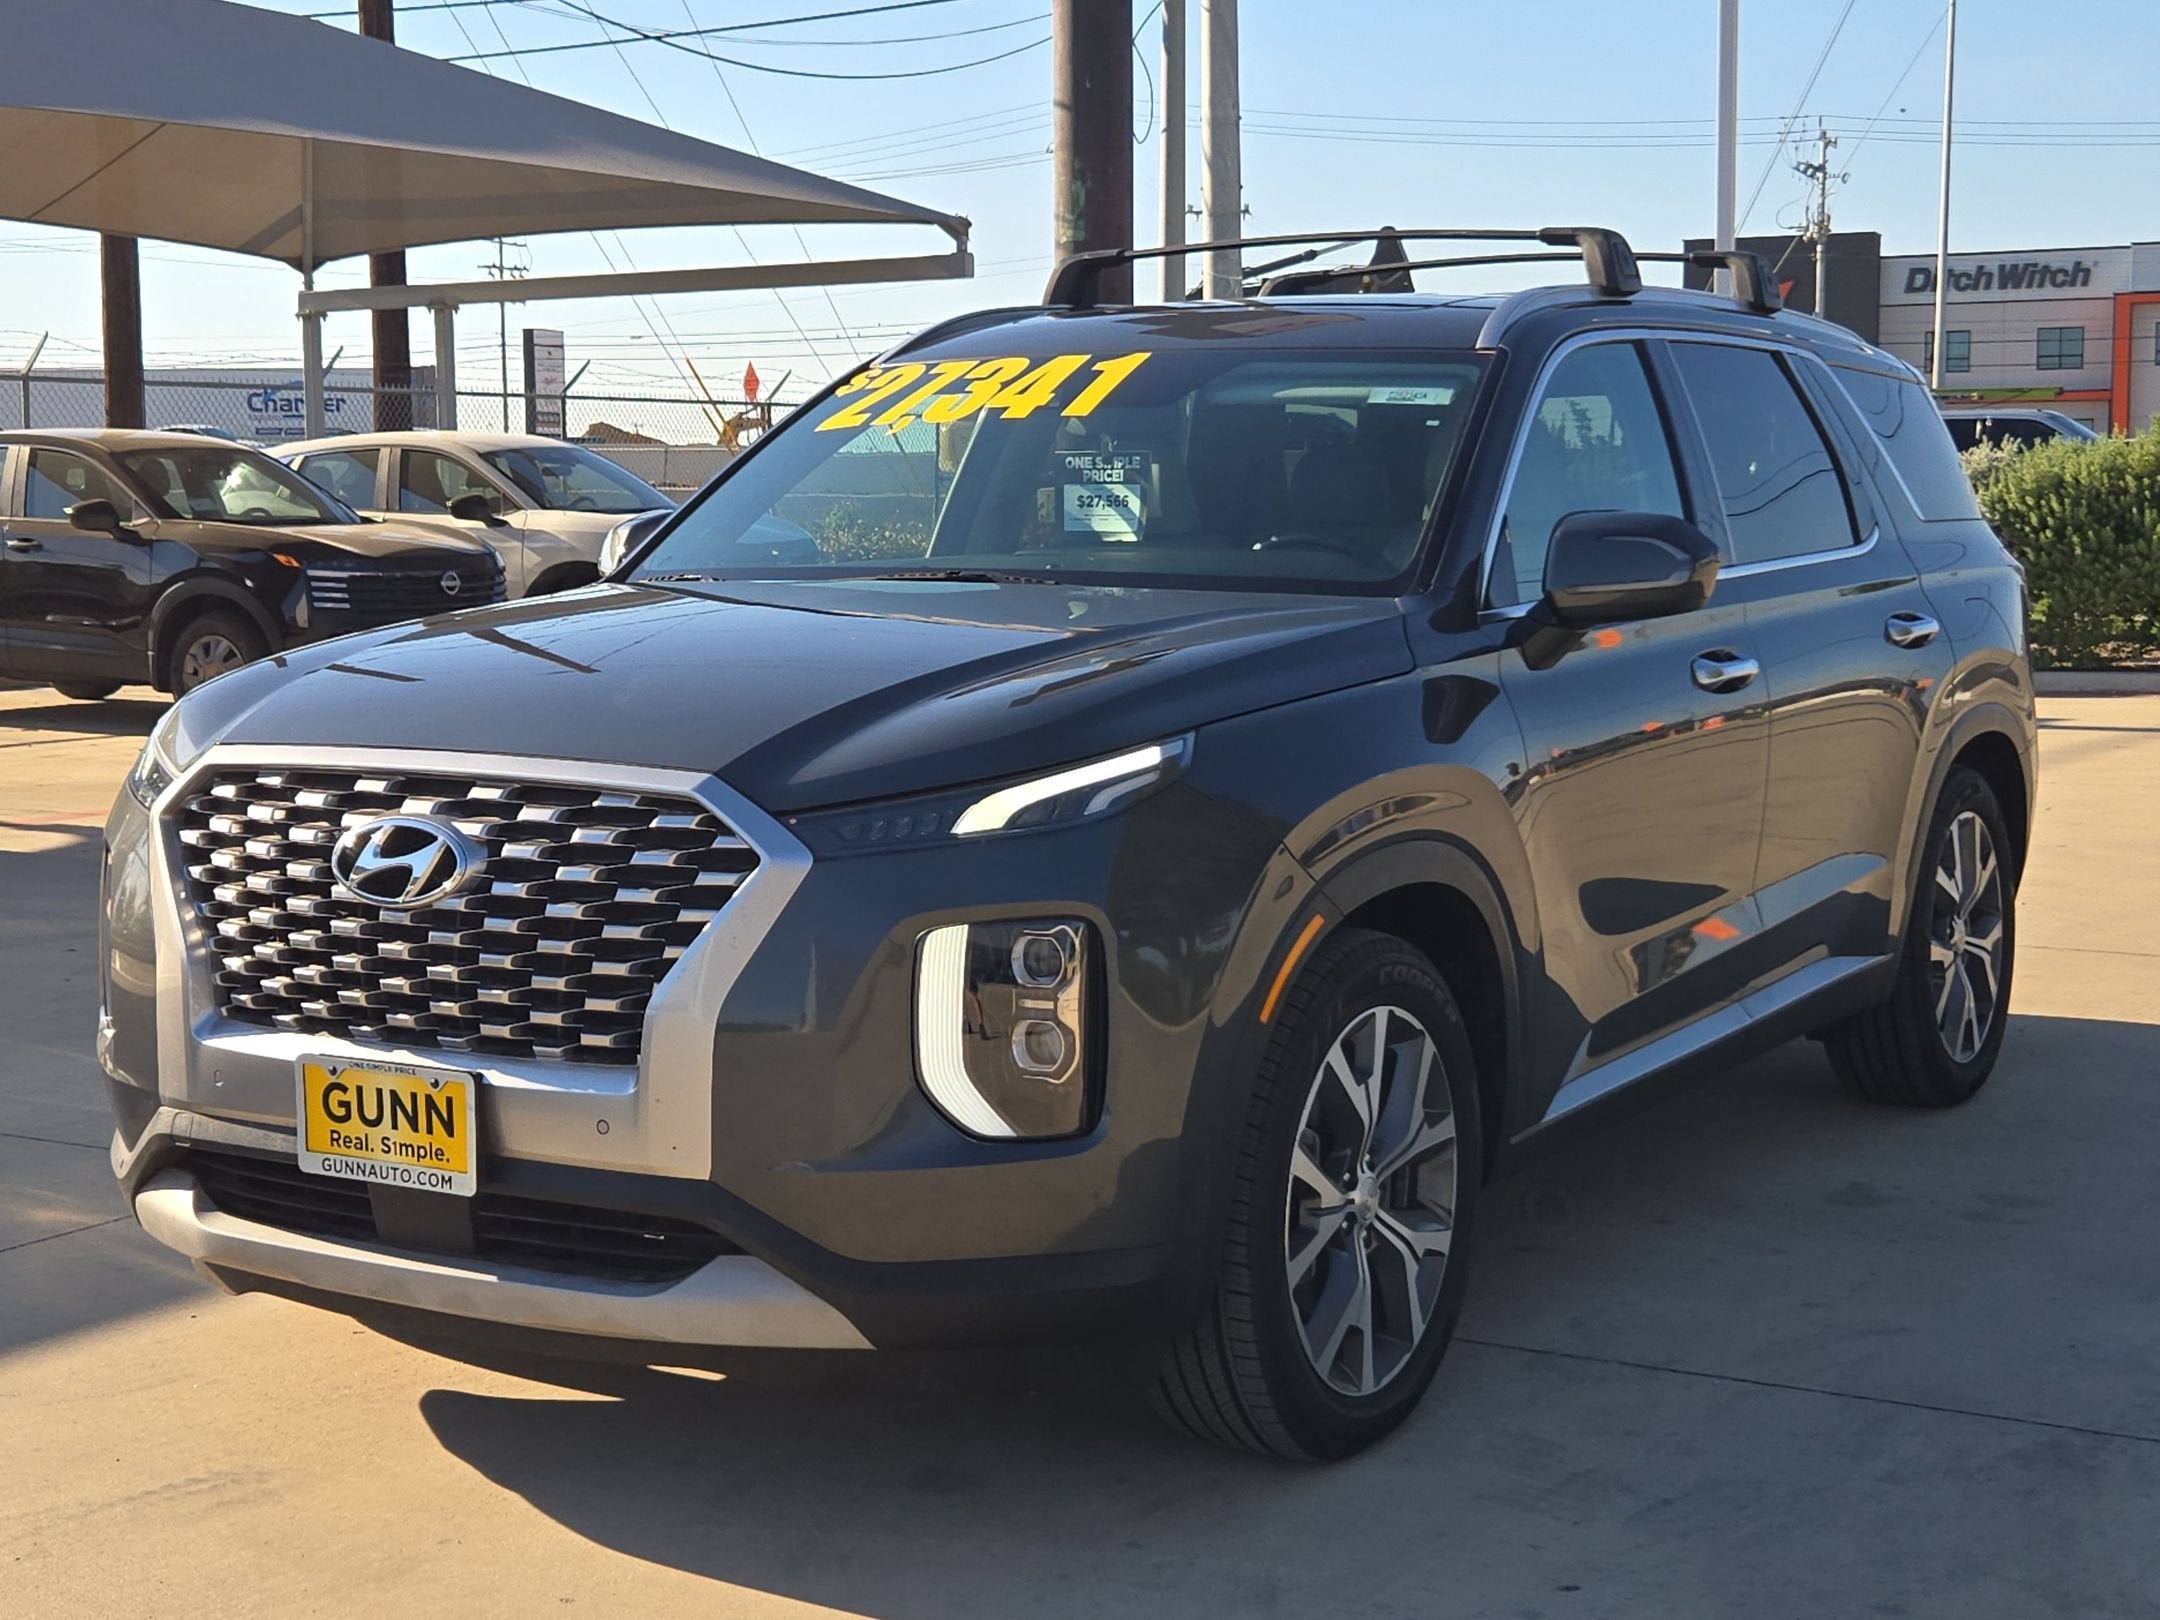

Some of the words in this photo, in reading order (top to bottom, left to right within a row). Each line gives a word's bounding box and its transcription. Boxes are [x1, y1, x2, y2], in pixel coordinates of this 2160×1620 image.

[1997, 261, 2092, 290] Witch
[247, 388, 347, 412] Charer
[814, 352, 1152, 436] $27,341
[1065, 456, 1093, 469] ONE
[1095, 456, 1141, 469] SPLE
[1076, 494, 1129, 510] $27,566
[394, 1066, 417, 1076] PRICE
[322, 1081, 455, 1138] GUNN
[329, 1129, 374, 1152] Real.
[321, 1157, 453, 1190] GUNNAUTO.COM
